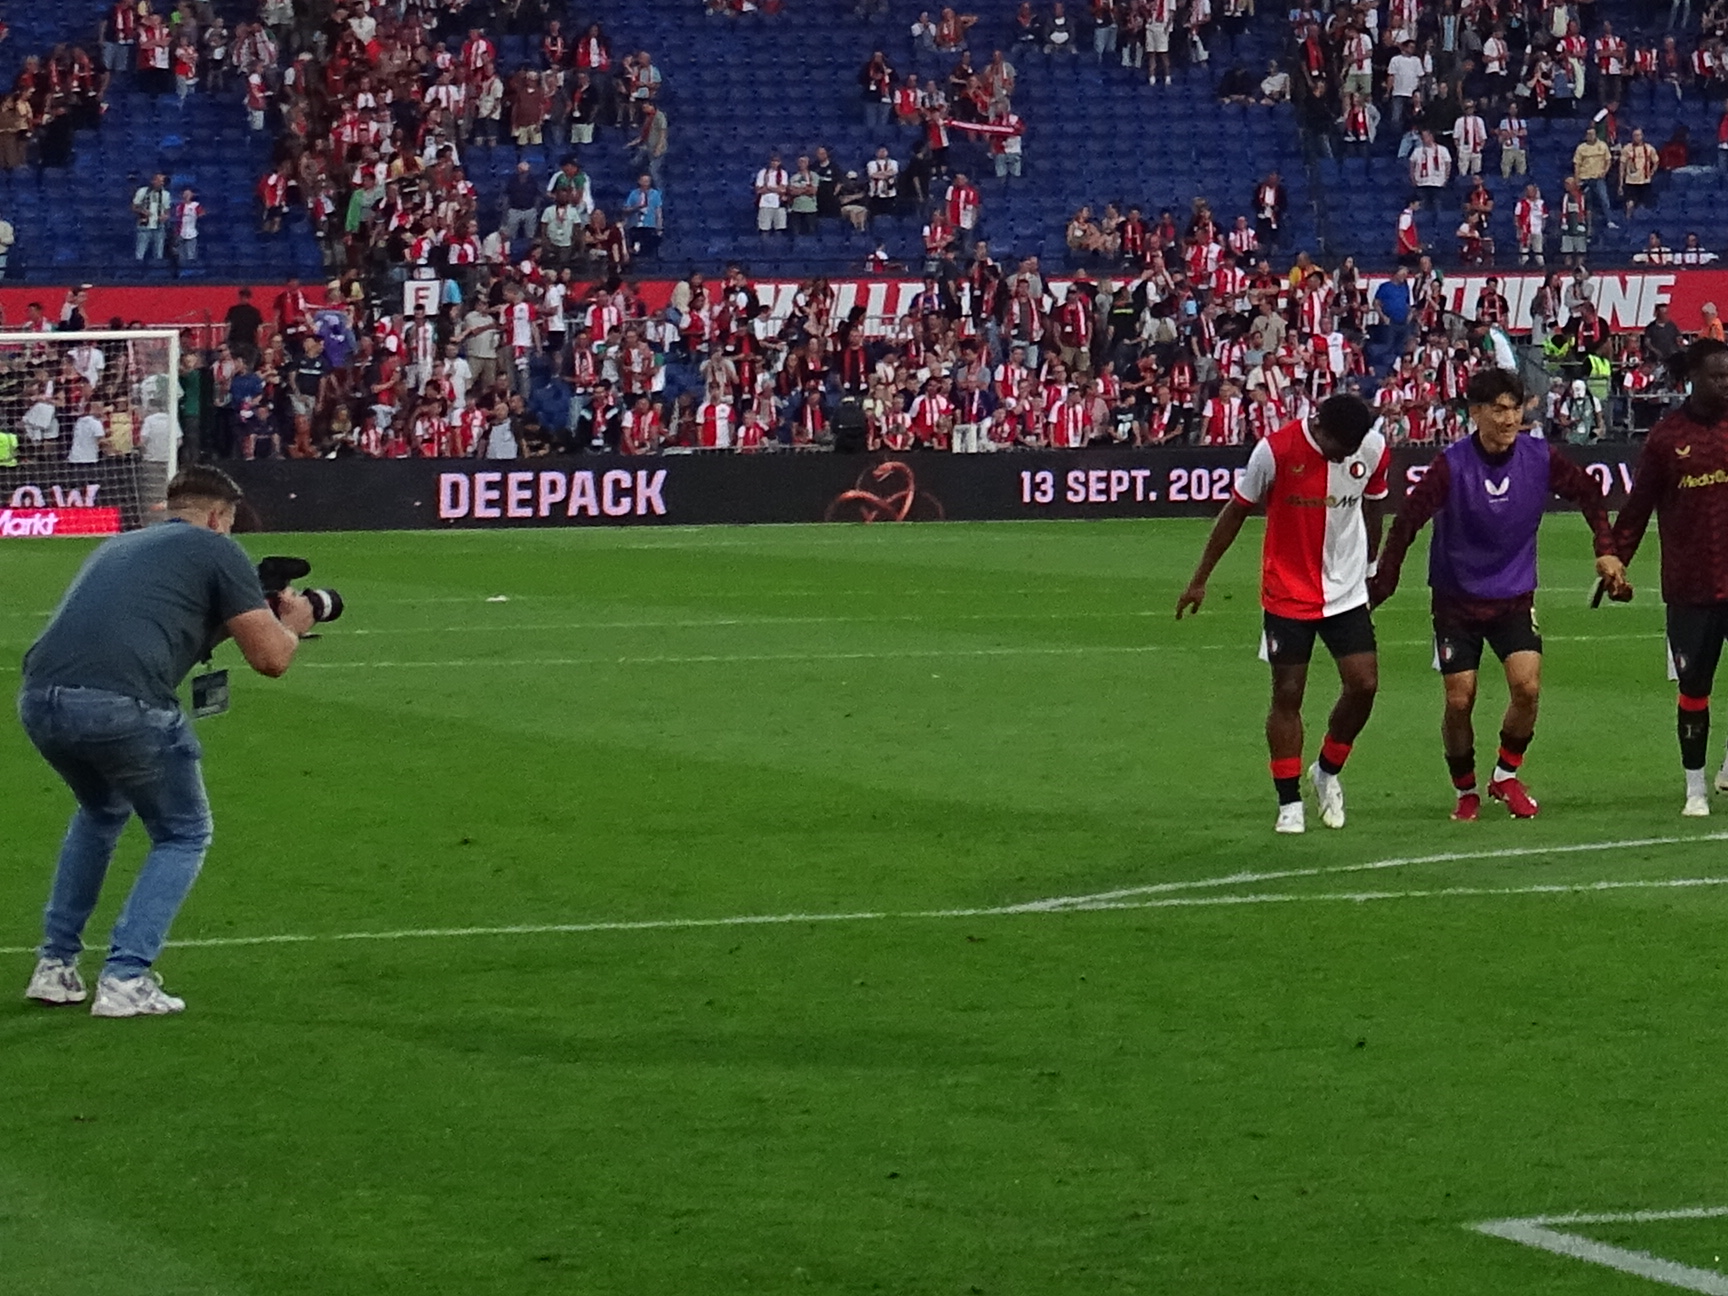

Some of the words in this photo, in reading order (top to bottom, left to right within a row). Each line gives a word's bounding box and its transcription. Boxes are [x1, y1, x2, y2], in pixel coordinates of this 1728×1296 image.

[415, 286, 430, 307] F
[439, 468, 668, 519] DEEPACK
[1020, 470, 1055, 503] 13
[1066, 469, 1158, 503] SEPT.
